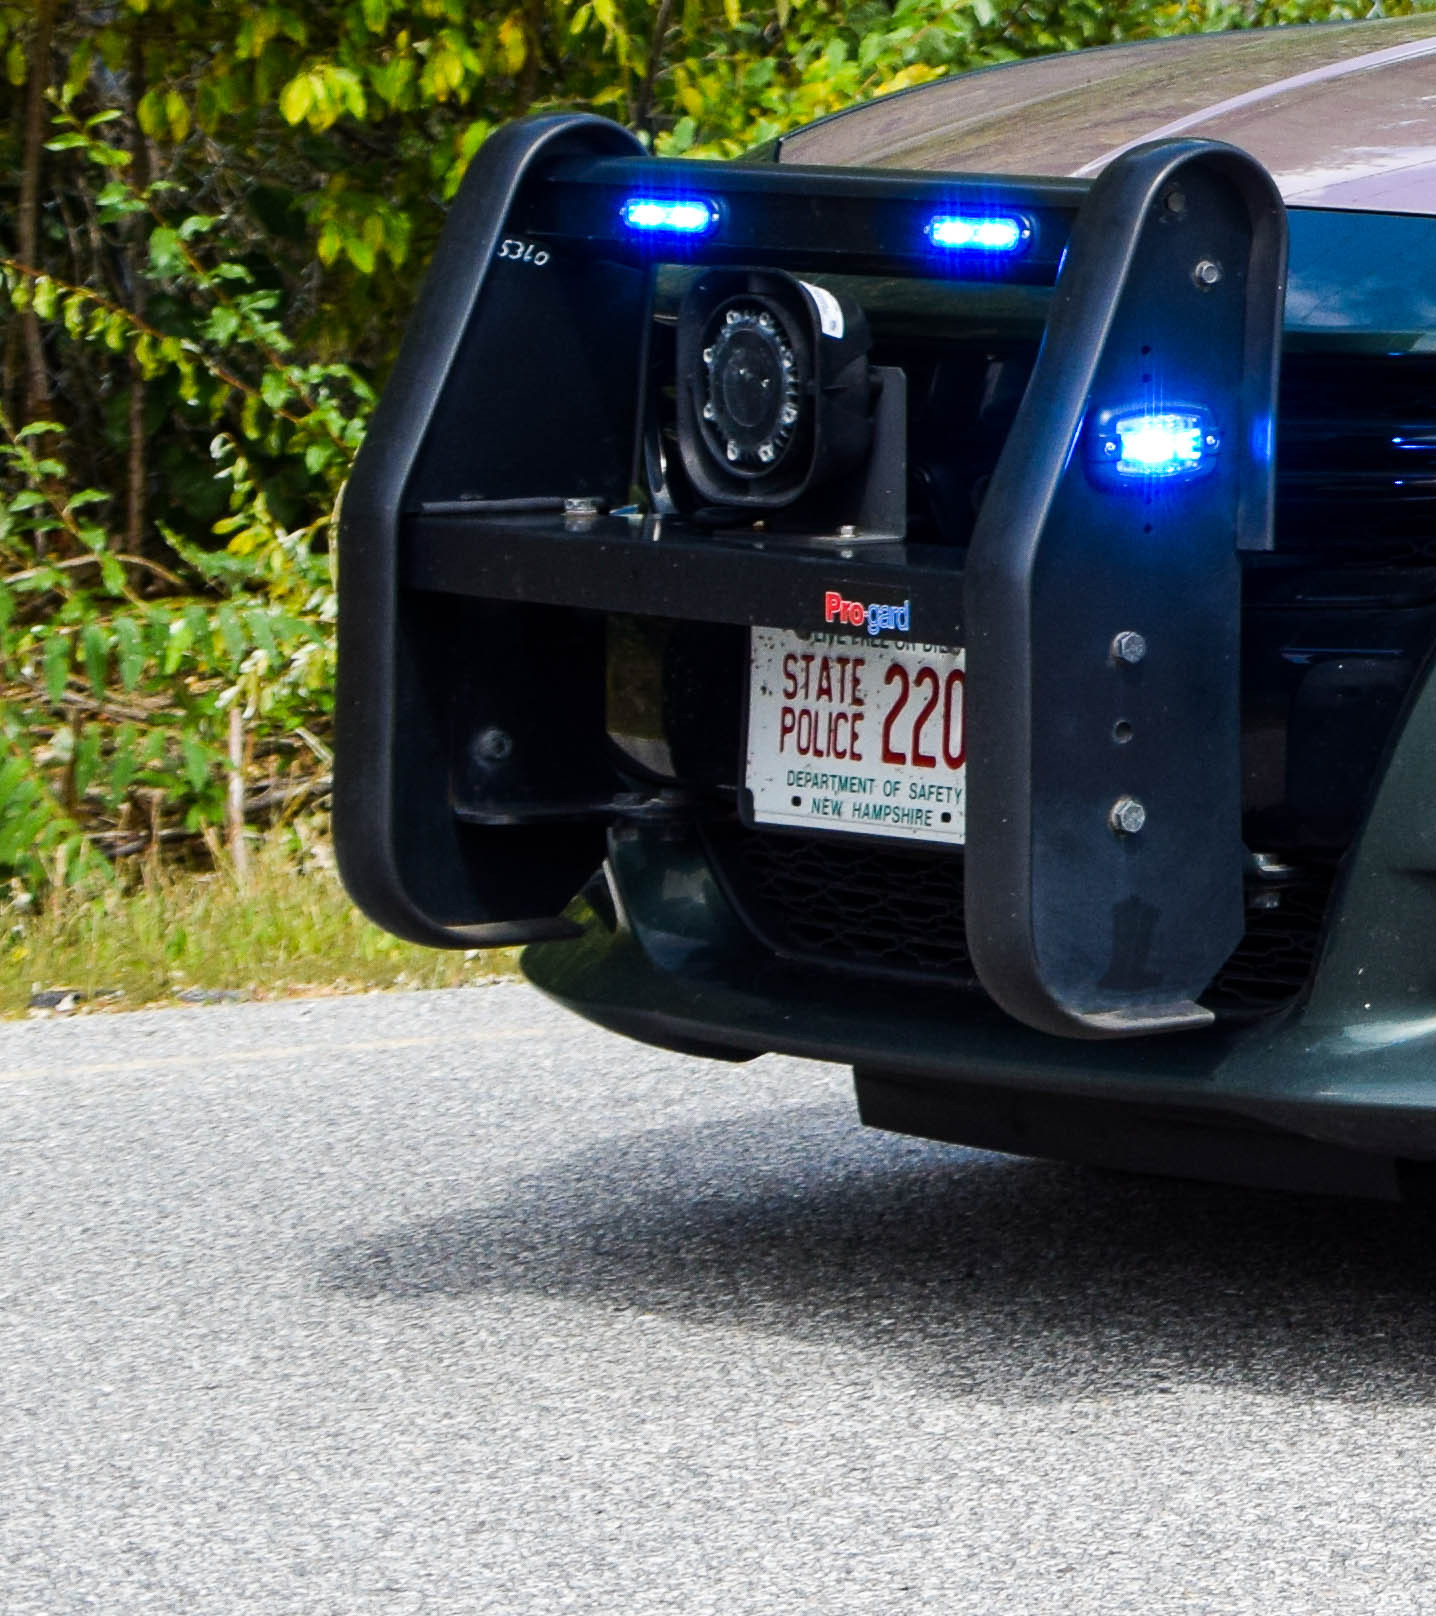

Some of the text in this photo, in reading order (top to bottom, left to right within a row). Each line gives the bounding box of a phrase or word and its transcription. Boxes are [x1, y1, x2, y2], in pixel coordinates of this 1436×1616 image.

[824, 591, 911, 635] Pro-gard
[782, 653, 966, 770] STATE 220
[779, 706, 865, 762] POLICE
[786, 770, 964, 805] DEPARTMENT OF SAFETY
[810, 796, 934, 827] NEW HAMPSHIRE
